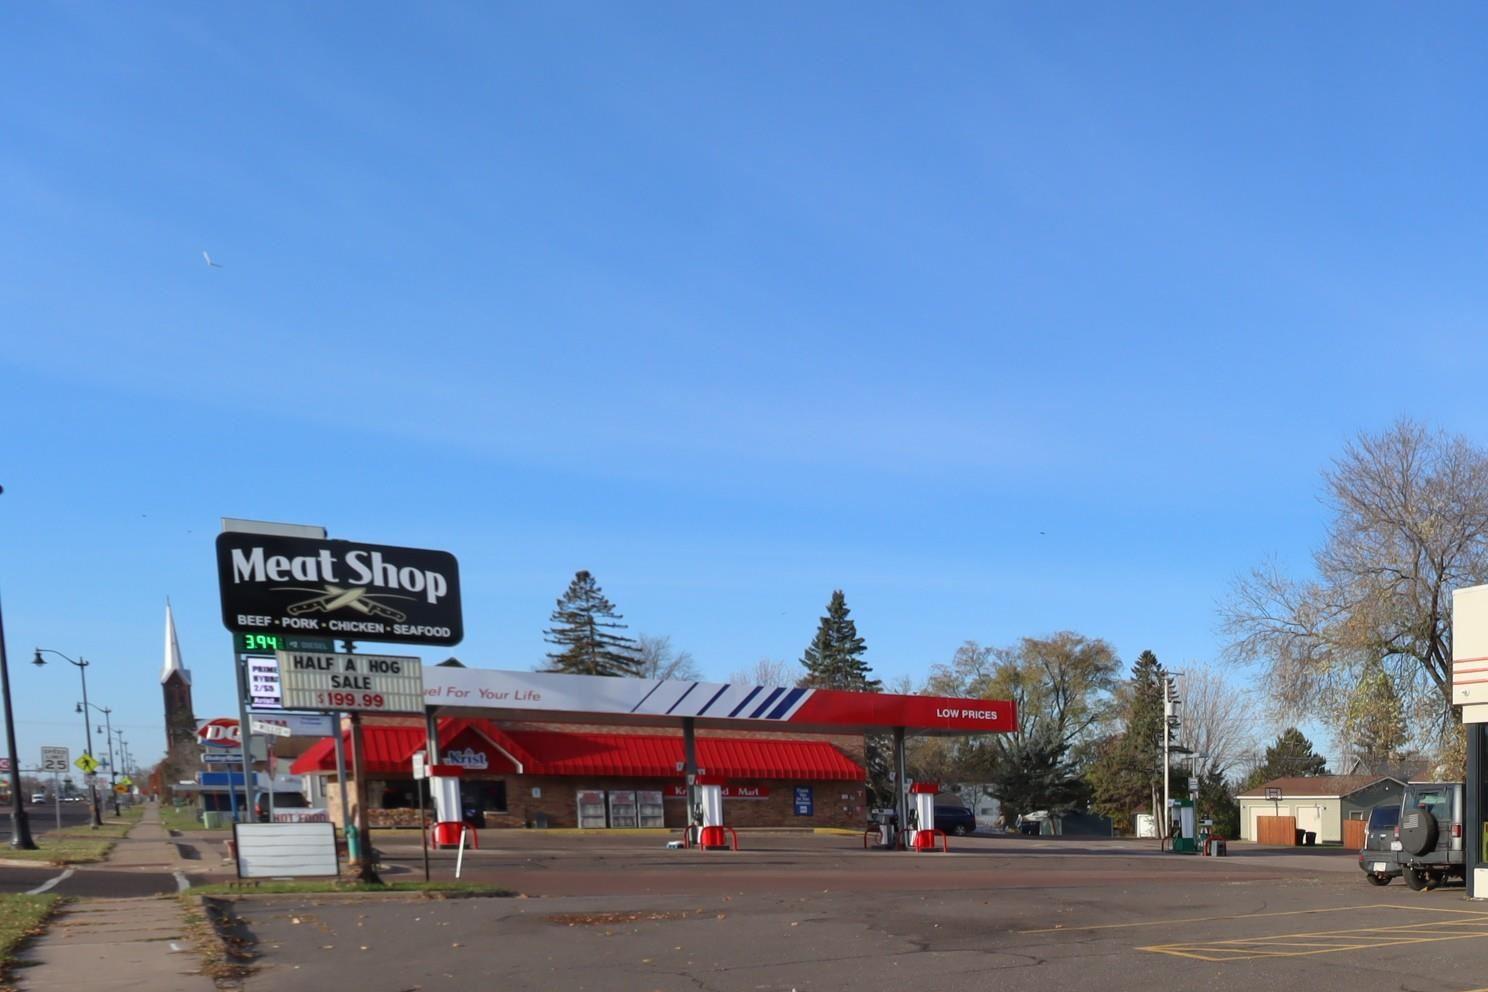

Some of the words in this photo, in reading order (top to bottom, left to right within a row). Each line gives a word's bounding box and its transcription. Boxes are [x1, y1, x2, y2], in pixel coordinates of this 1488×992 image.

[231, 547, 339, 584] Meat
[344, 550, 447, 604] Shop
[237, 614, 272, 627] BEEF
[281, 616, 319, 630] PORK
[329, 619, 384, 634] CHICKEN
[392, 623, 451, 638] SEAFOOD
[293, 655, 335, 671] HALF
[345, 658, 356, 672] A
[369, 659, 401, 674] HOG
[331, 674, 372, 691] SALE
[316, 691, 385, 708] $199.99
[422, 686, 442, 697] uel
[446, 686, 471, 699] For
[478, 687, 510, 700] Your
[514, 689, 541, 702] Life
[936, 708, 960, 718] LOW
[962, 710, 998, 720] PRICES
[45, 760, 67, 770] 25
